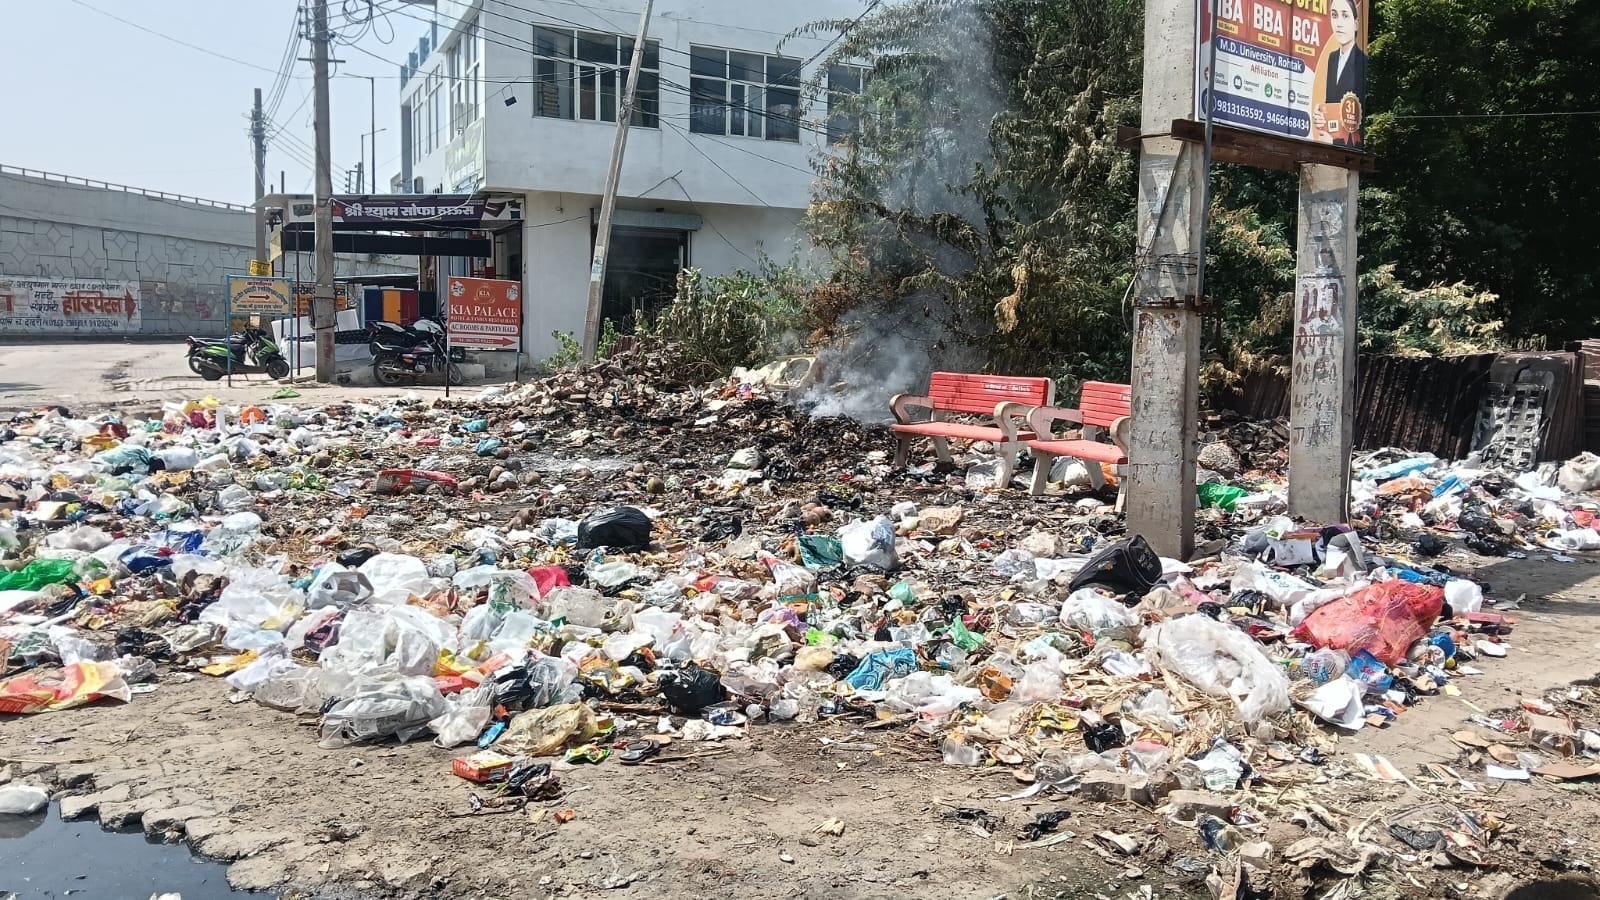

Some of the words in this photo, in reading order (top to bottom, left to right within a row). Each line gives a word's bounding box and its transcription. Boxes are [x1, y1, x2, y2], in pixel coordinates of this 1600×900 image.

[1253, 2, 1284, 36] BBA
[1292, 15, 1320, 47] BCA
[1220, 39, 1238, 54] M.D.
[1240, 44, 1277, 66] University,
[1278, 55, 1302, 71] Rohtak
[1250, 64, 1279, 79] Affiliation
[1217, 99, 1266, 123] 9813163592,
[1266, 112, 1309, 131] 9466468434
[1345, 100, 1356, 114] 31
[345, 202, 362, 217] श्री
[400, 202, 435, 217] सोफा
[450, 304, 471, 316] KIA
[474, 305, 518, 318] PALACE
